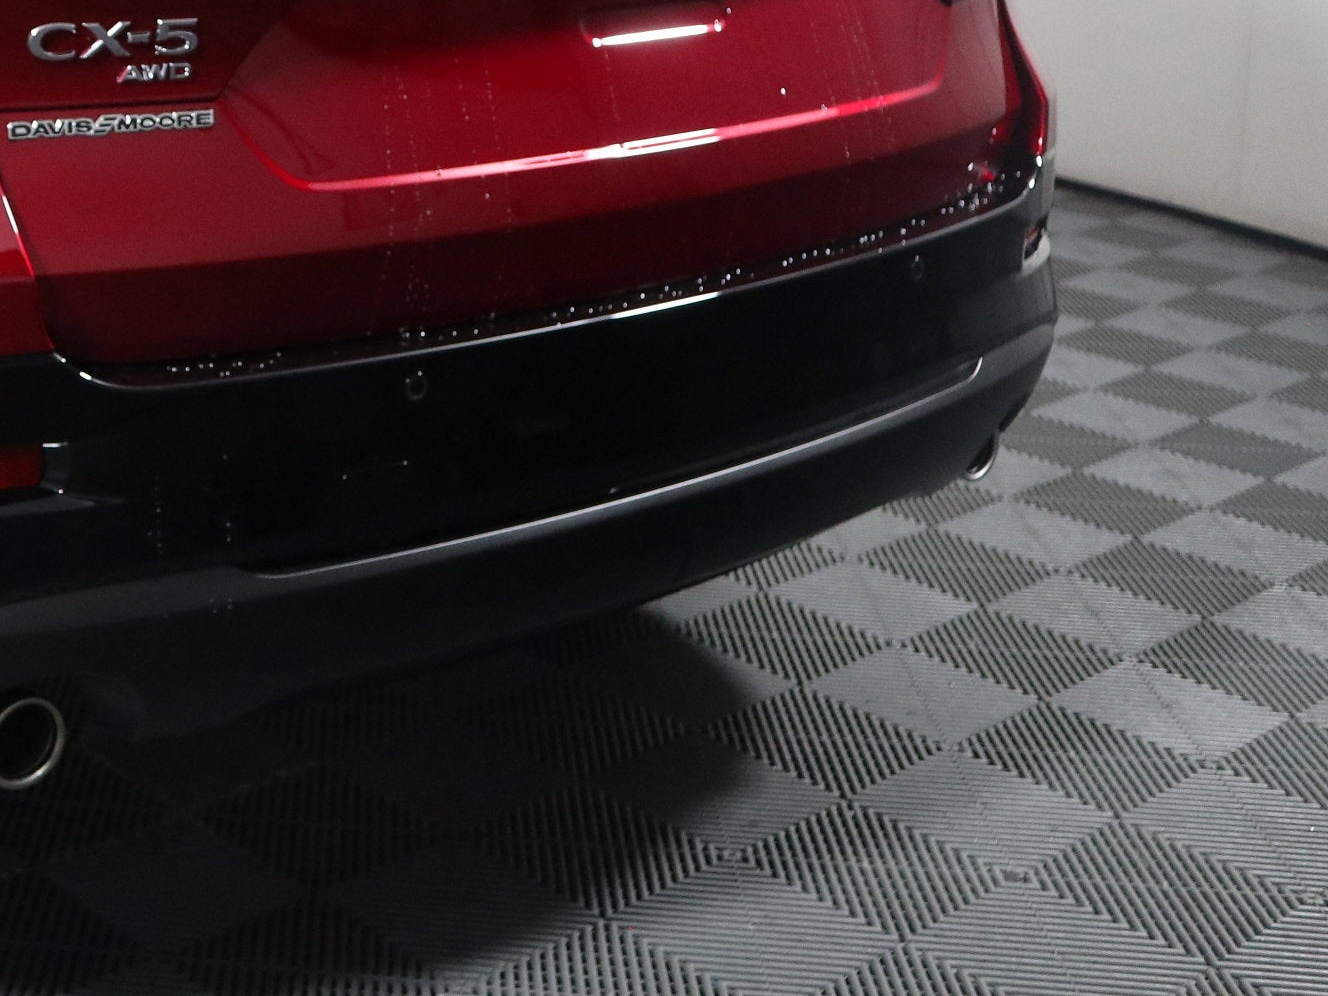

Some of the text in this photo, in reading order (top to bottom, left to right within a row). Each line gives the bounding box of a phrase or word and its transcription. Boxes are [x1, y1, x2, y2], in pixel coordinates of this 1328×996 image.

[27, 17, 199, 61] CX-5
[116, 62, 192, 83] AWD
[8, 110, 214, 139] DAVIS MOORE
